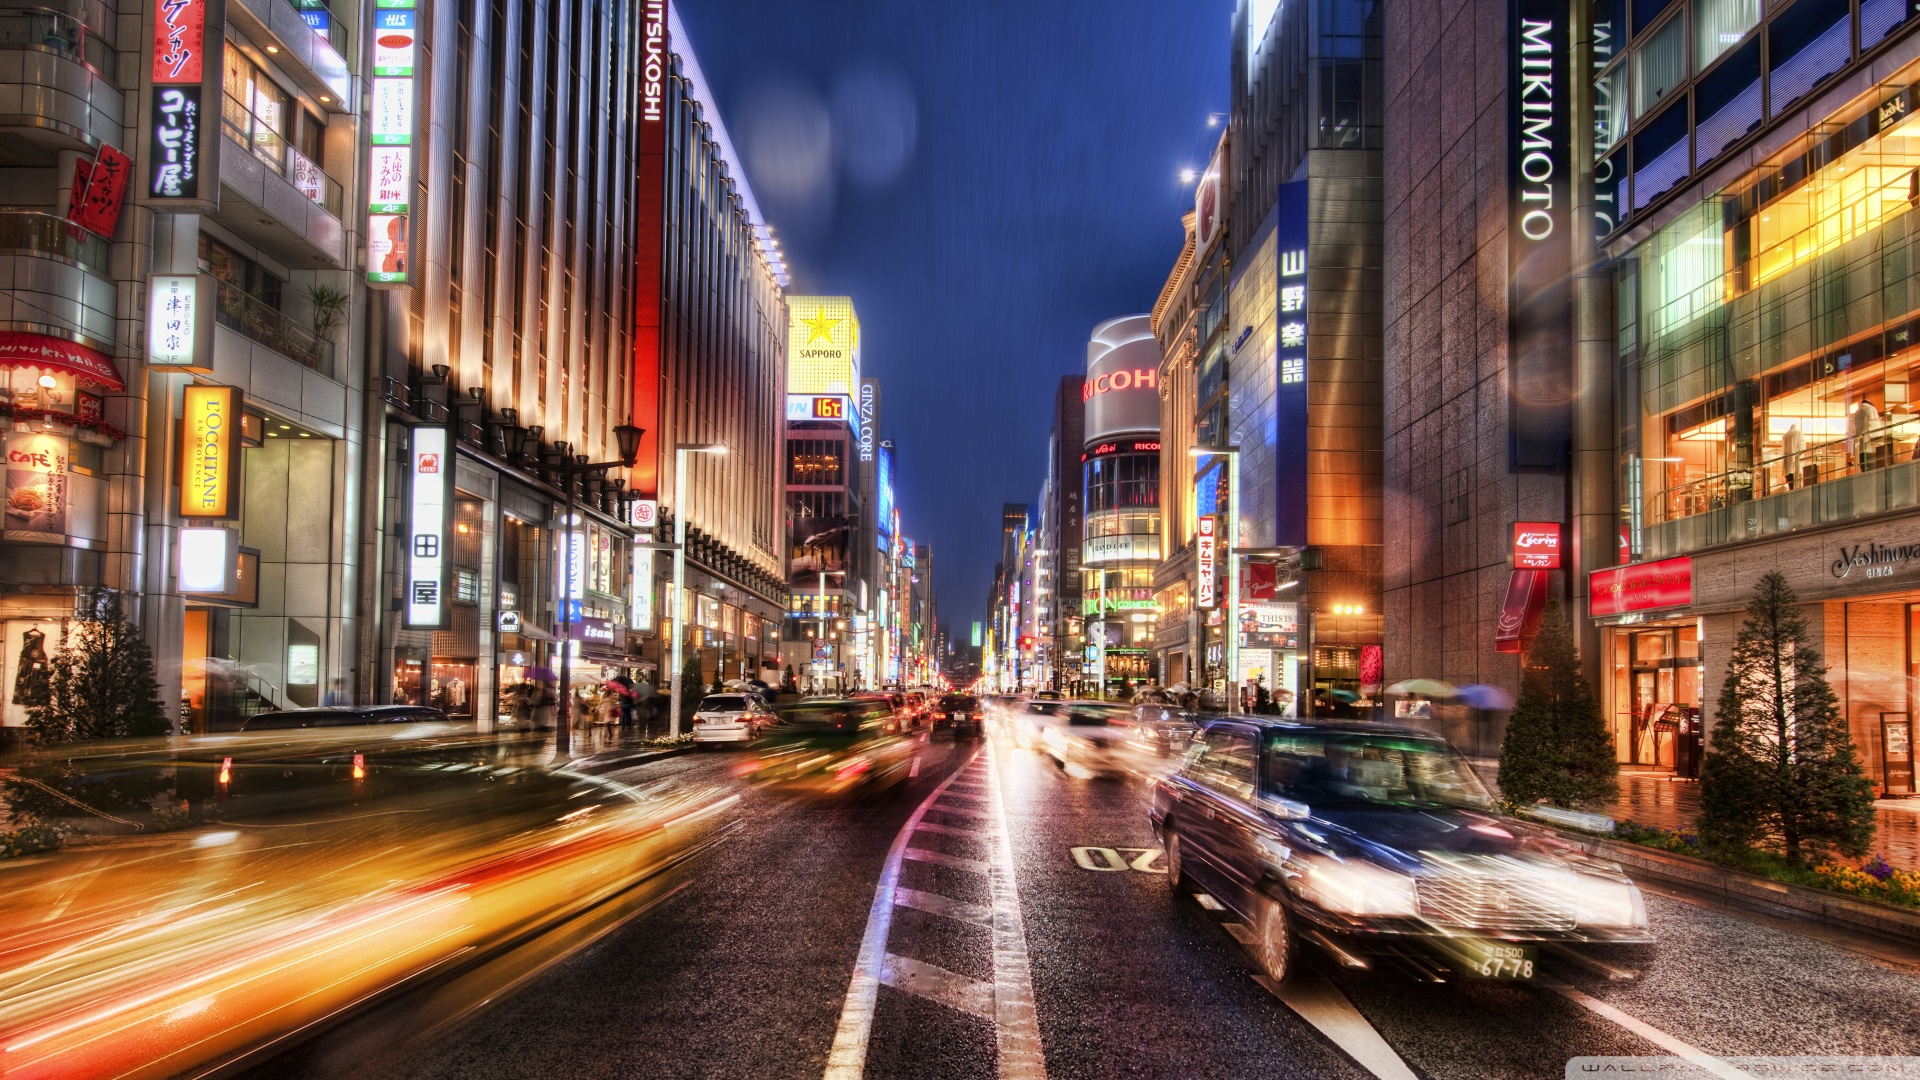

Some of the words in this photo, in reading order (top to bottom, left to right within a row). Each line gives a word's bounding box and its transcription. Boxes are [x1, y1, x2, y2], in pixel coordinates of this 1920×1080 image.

[645, 0, 663, 121] ITSUKOSHI
[154, 89, 184, 196] コーヒー屋
[1521, 18, 1553, 241] MIKIMOTO
[380, 155, 391, 187] すみか
[382, 204, 399, 212] 4F
[380, 272, 397, 281] 3F
[1282, 250, 1305, 384] 山野楽器
[800, 349, 842, 359] SAPPORO
[1082, 369, 1156, 404] RICOH
[861, 384, 873, 425] GINZA
[197, 420, 203, 432] EN
[202, 400, 222, 509] L'OCCITANE
[860, 427, 873, 461] CORE
[194, 437, 202, 489] PROVENCE
[412, 534, 439, 605] 田屋
[1200, 541, 1212, 603] キムラヤのパン
[1653, 571, 1688, 586] Shop
[1866, 565, 1893, 578] GINZA
[1251, 581, 1275, 595] Fender
[1261, 614, 1283, 623] THIS
[1284, 614, 1293, 623] IS
[1481, 959, 1533, 978] 67-78
